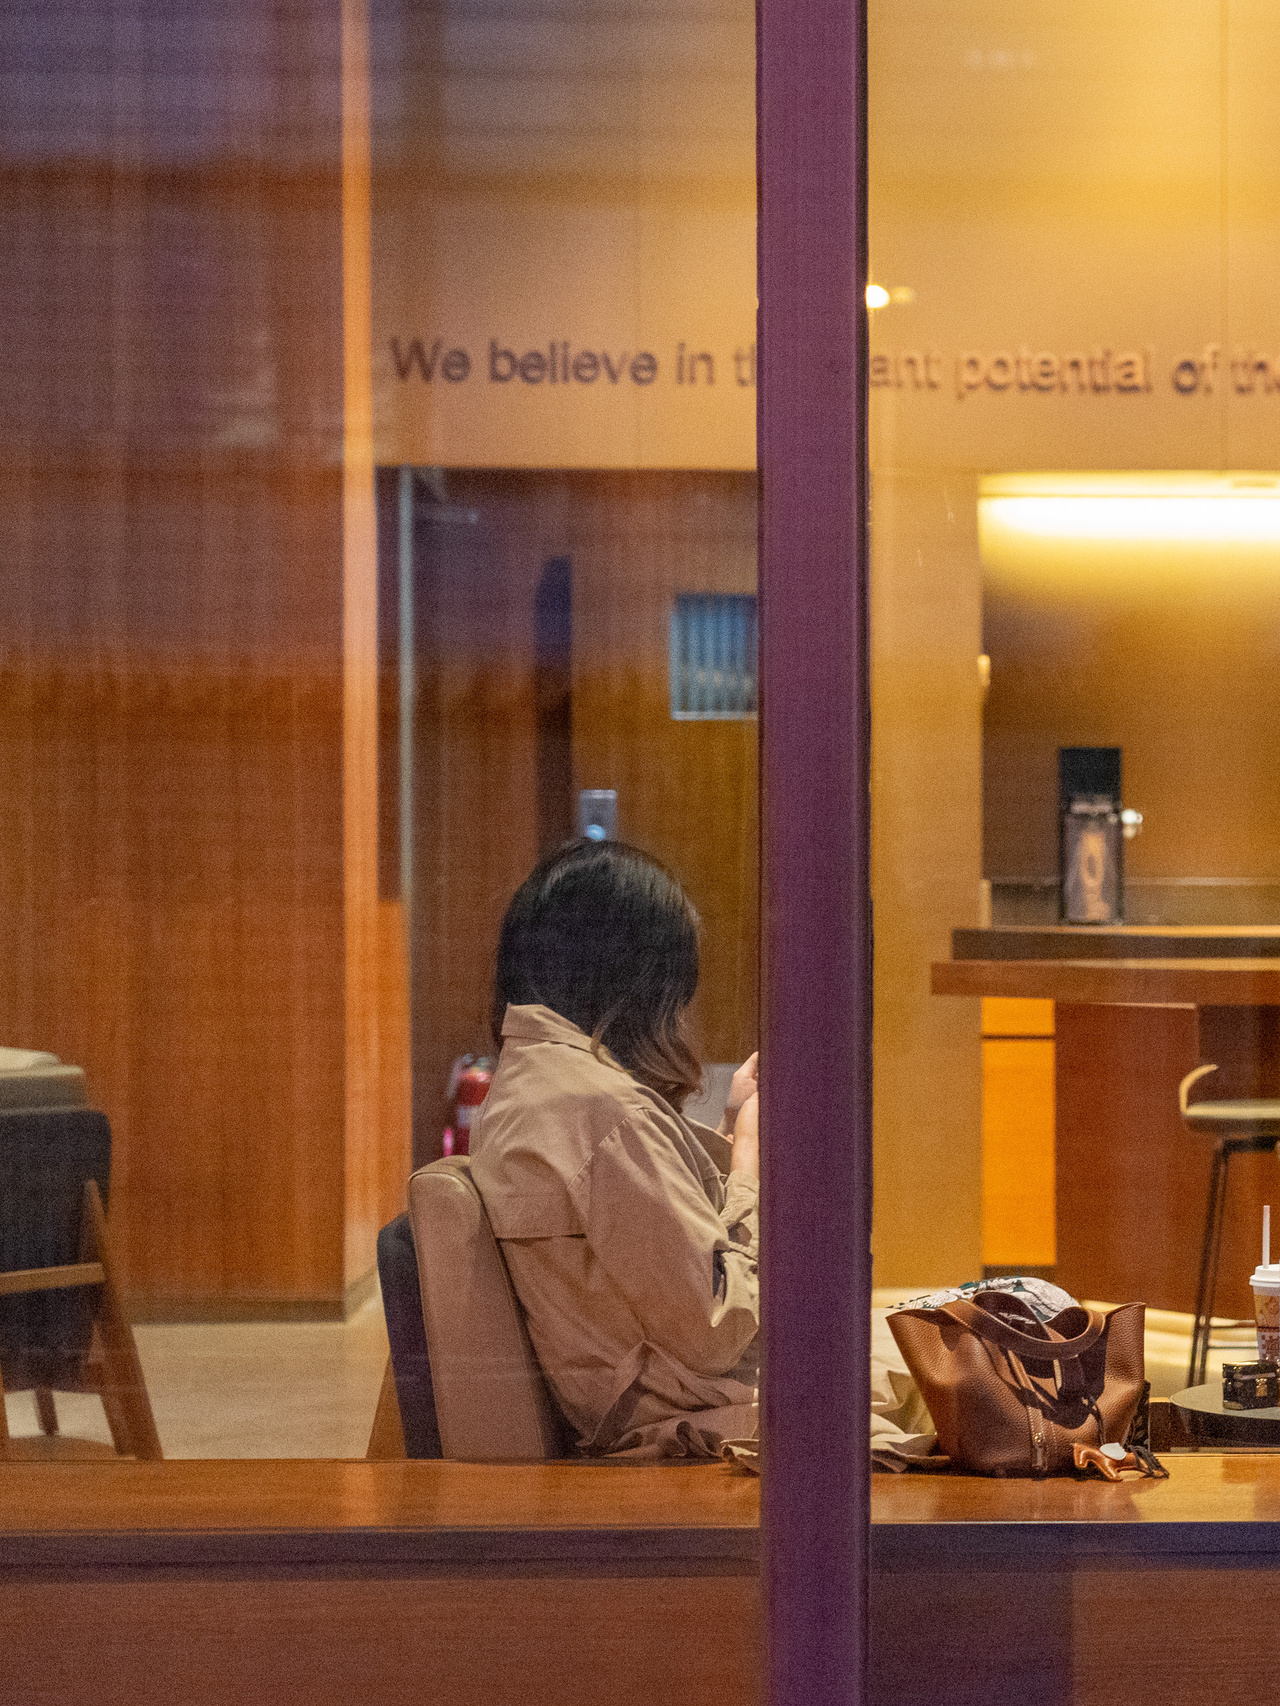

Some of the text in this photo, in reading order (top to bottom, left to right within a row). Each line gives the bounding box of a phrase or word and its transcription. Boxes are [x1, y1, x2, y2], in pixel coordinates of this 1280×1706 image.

[390, 337, 472, 386] We
[488, 340, 659, 387] believe
[675, 341, 716, 387] in
[868, 345, 938, 391] ant
[955, 346, 1152, 402] potential
[1171, 342, 1221, 397] of
